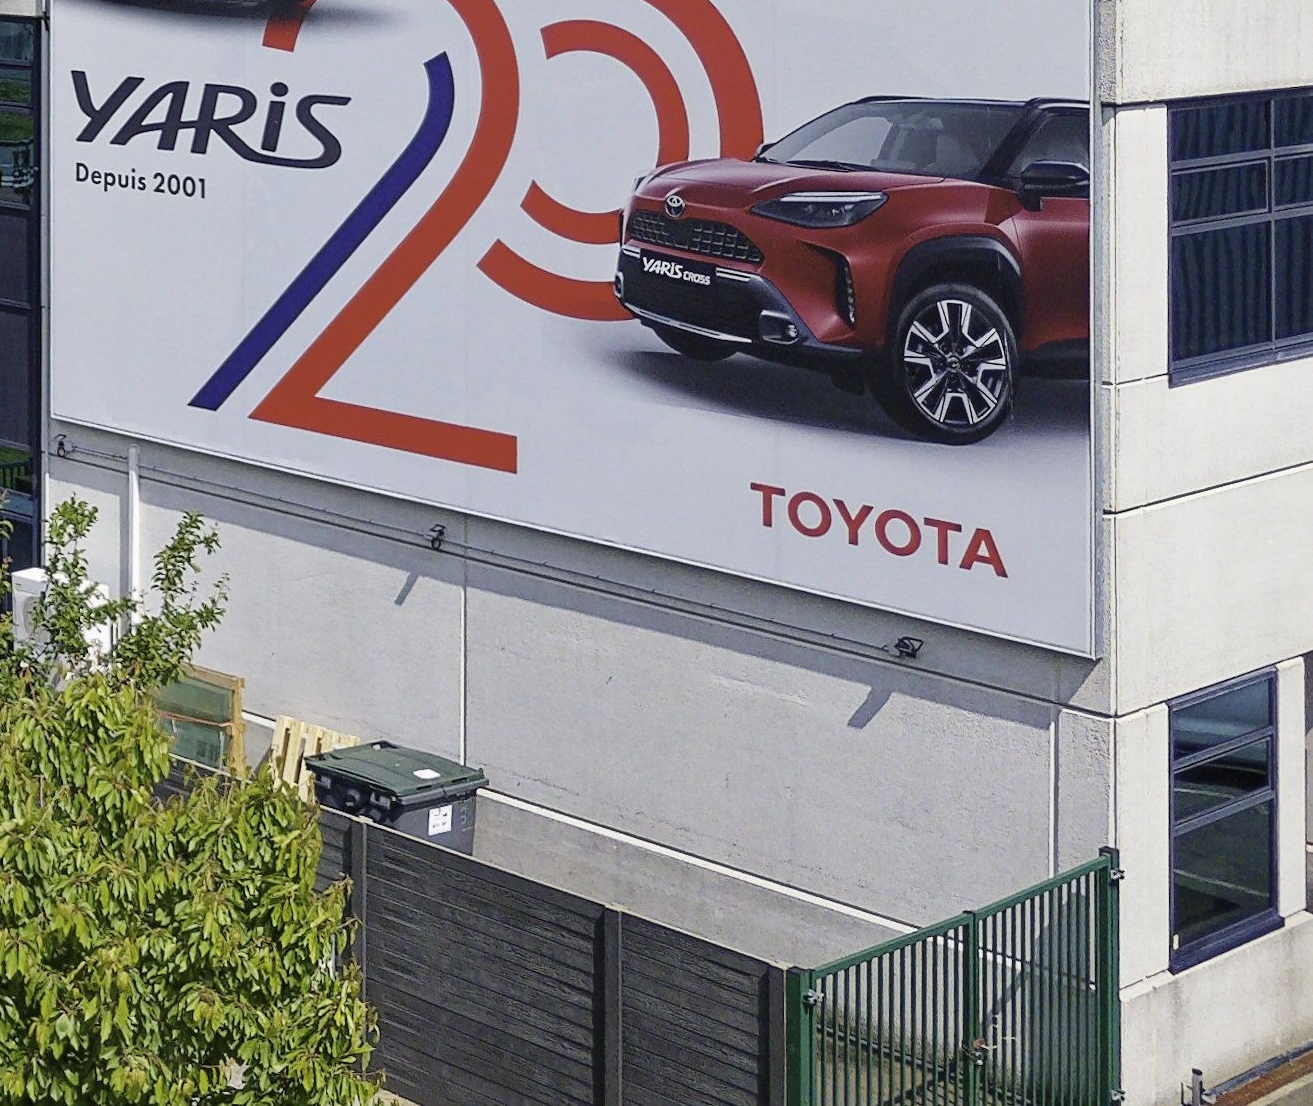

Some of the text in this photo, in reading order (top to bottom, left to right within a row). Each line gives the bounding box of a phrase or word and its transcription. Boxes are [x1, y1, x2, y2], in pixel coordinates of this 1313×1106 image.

[75, 162, 207, 198] Depuis 2001
[682, 270, 711, 286] CROSS
[749, 481, 1009, 579] TOYOTA
